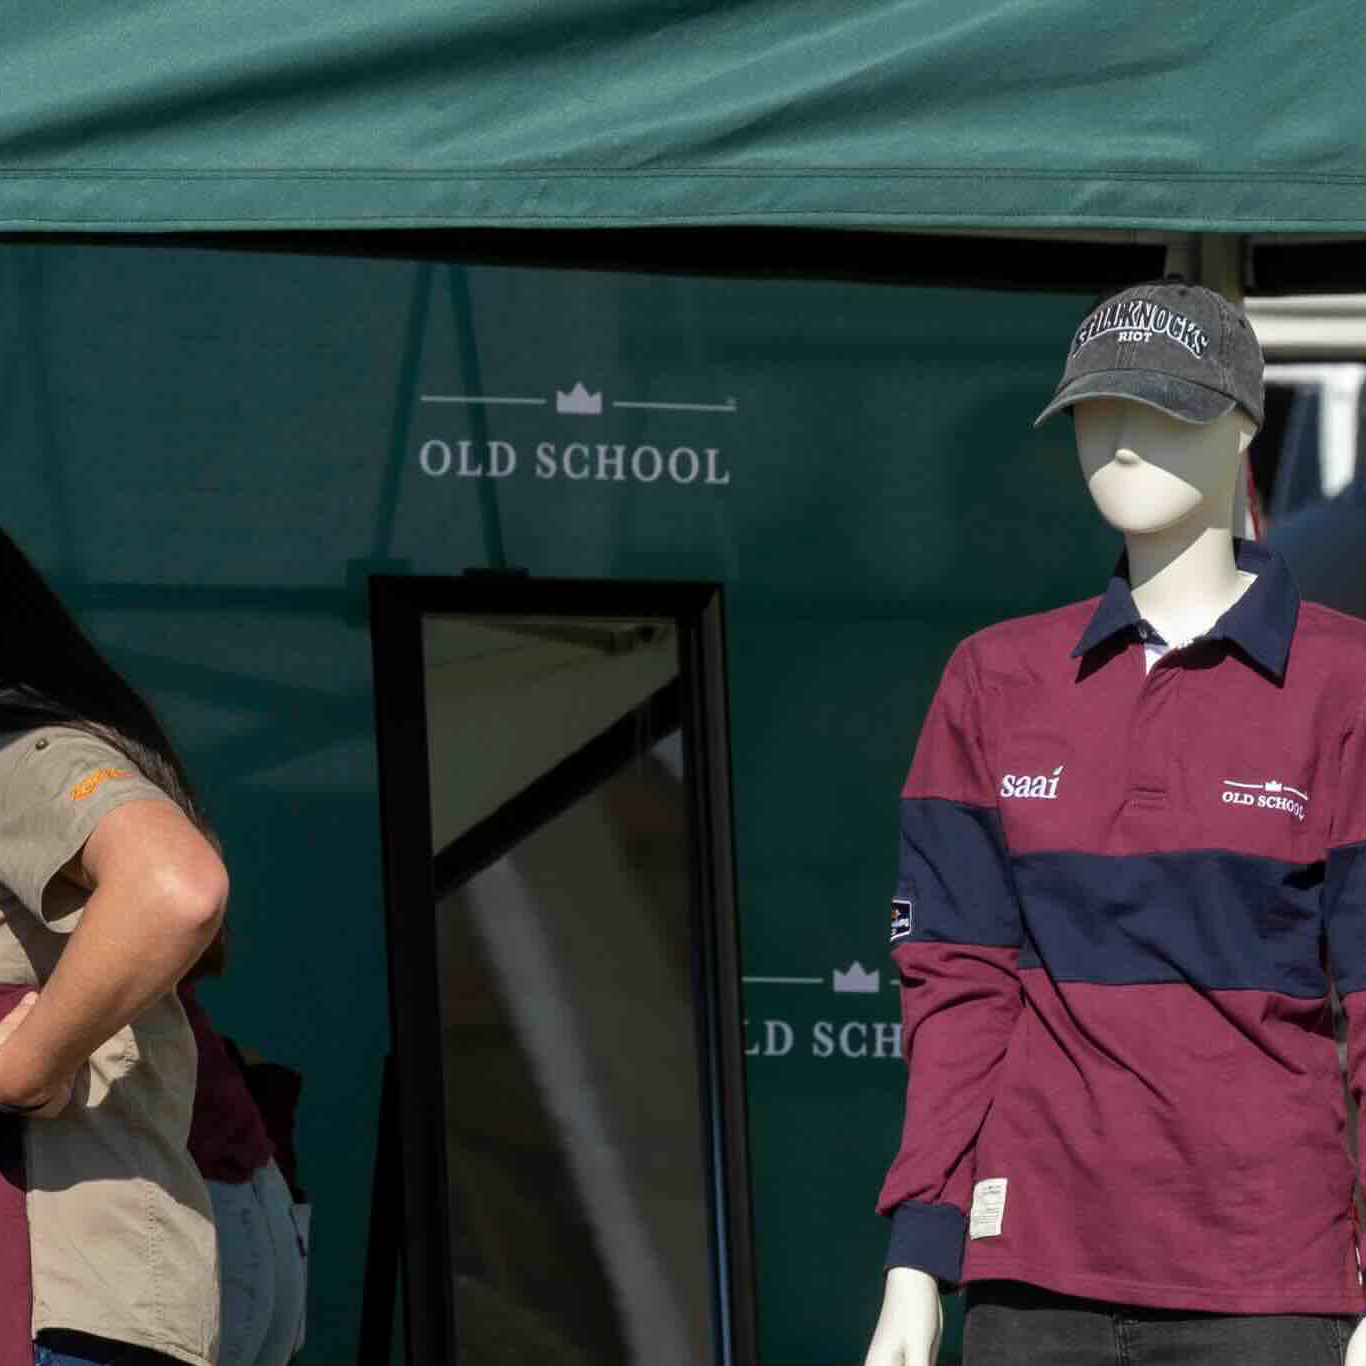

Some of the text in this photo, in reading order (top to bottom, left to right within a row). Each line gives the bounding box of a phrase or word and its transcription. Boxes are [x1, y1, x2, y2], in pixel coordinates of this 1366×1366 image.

[1117, 331, 1152, 342] RIOT
[419, 439, 730, 484] OLD SCHOOL
[1000, 766, 1063, 799] saai
[1222, 791, 1305, 821] OLD SCHOOL
[812, 1021, 903, 1058] SCH
